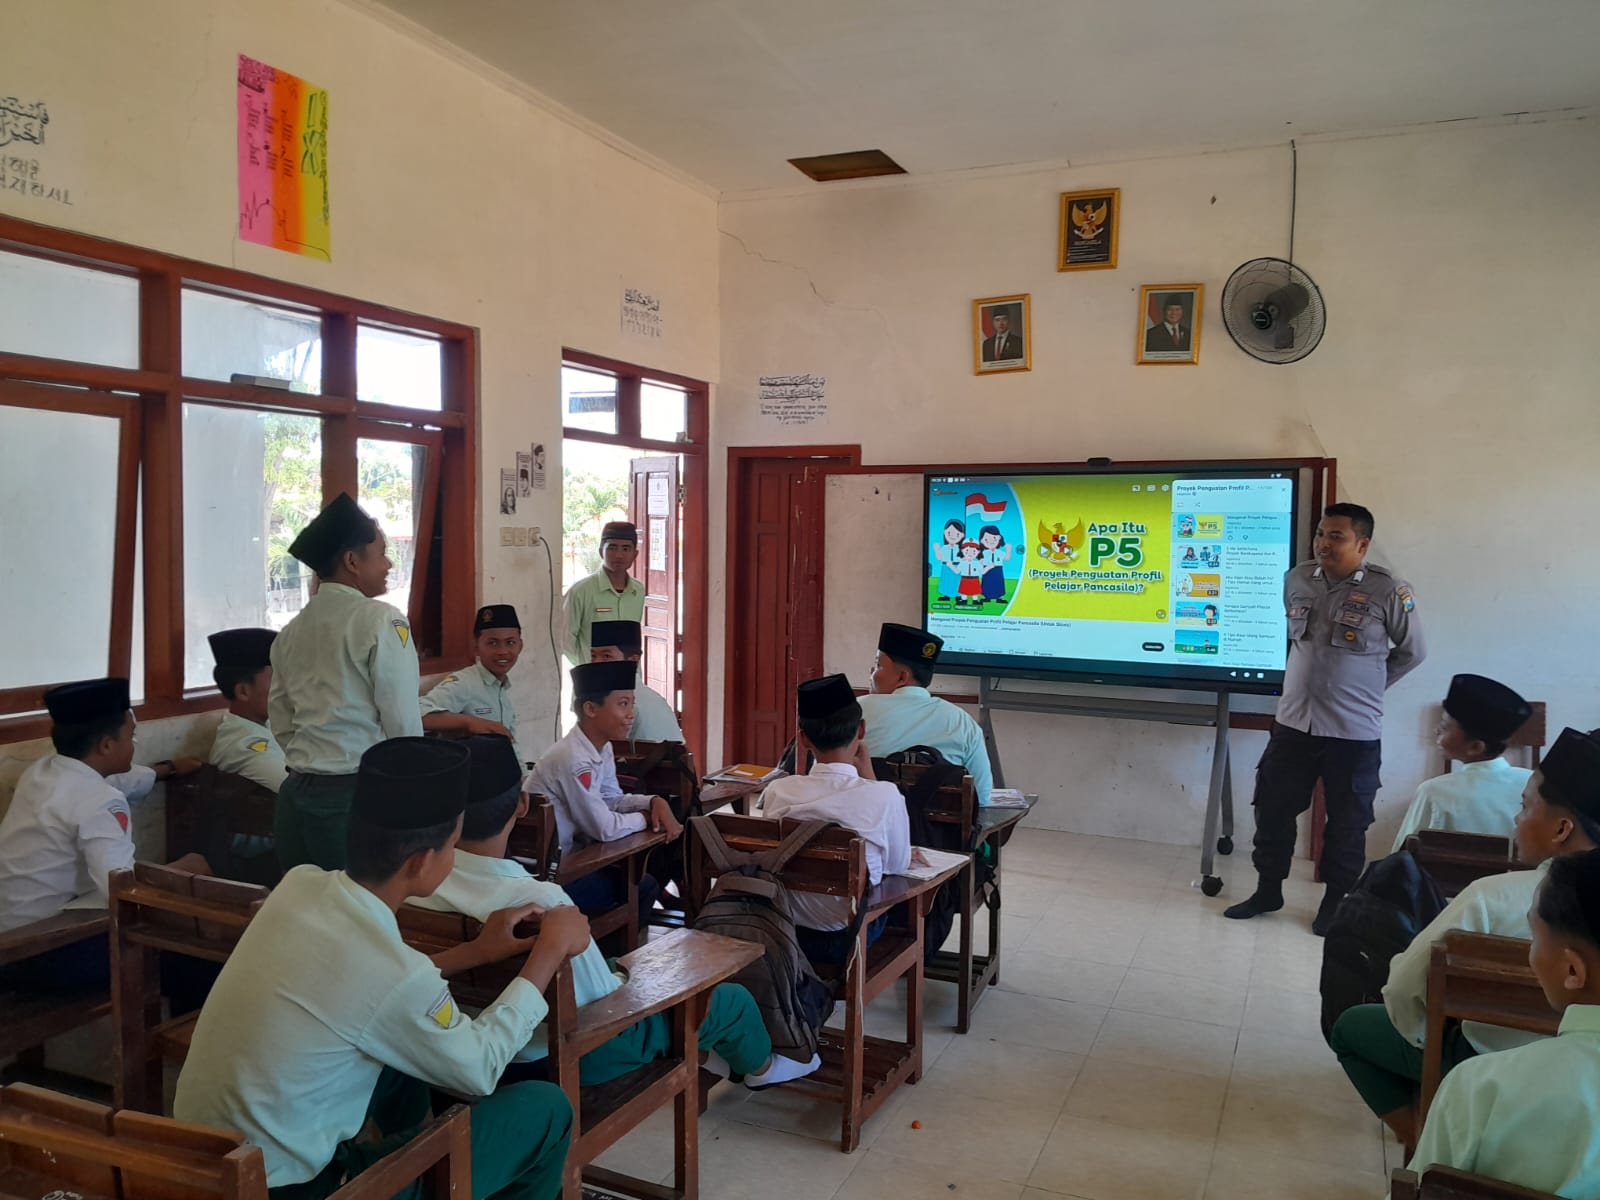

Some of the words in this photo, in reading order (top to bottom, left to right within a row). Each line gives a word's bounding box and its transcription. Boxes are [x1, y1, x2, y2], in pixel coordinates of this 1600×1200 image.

[1088, 522, 1118, 535] Apa
[1121, 522, 1145, 533] Itu
[1090, 537, 1142, 567] P5
[1029, 569, 1069, 580] (Proyek
[1071, 570, 1128, 581] Penguatan
[1131, 571, 1161, 580] Profil
[1045, 582, 1082, 592] Pelajar
[1084, 583, 1144, 592] Pancasila)?
